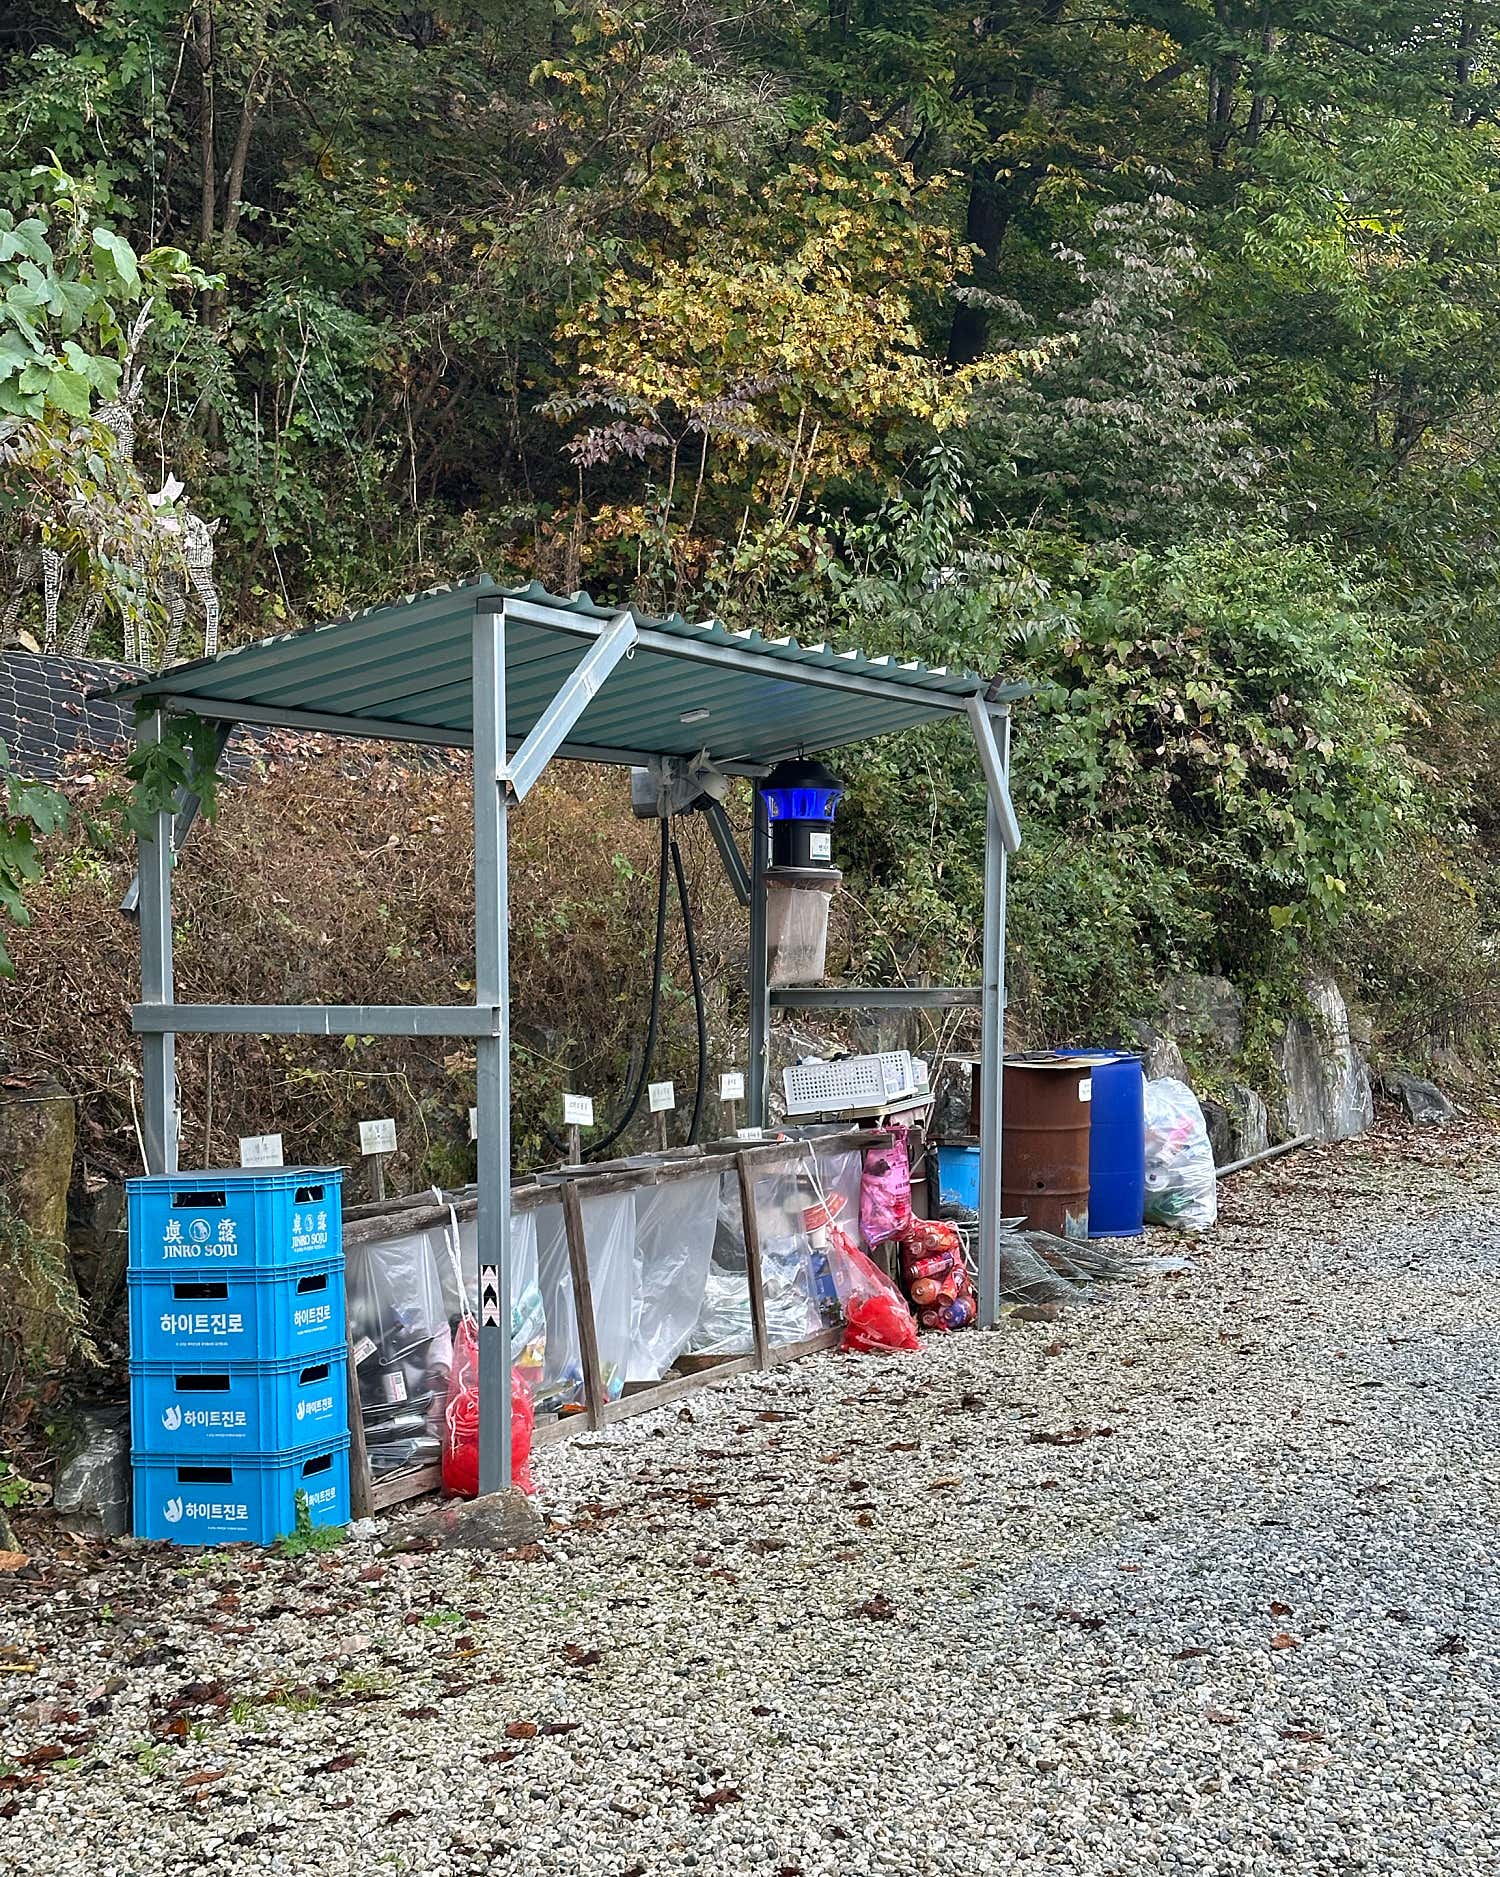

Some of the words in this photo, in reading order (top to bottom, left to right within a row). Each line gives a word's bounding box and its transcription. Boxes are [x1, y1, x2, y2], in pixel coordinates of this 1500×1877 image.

[218, 1218, 237, 1243] 露
[291, 1234, 310, 1249] JINRO
[311, 1231, 328, 1245] SOJU
[162, 1244, 201, 1259] JINRO
[204, 1244, 238, 1258] SOJU
[160, 1313, 244, 1335] 하이트진로
[294, 1304, 331, 1327] 하이트진로
[305, 1397, 333, 1416] 하이트진로
[183, 1411, 247, 1428] 하이트진로
[308, 1487, 336, 1507] 하이트진로
[185, 1503, 249, 1521] 하이트진로
